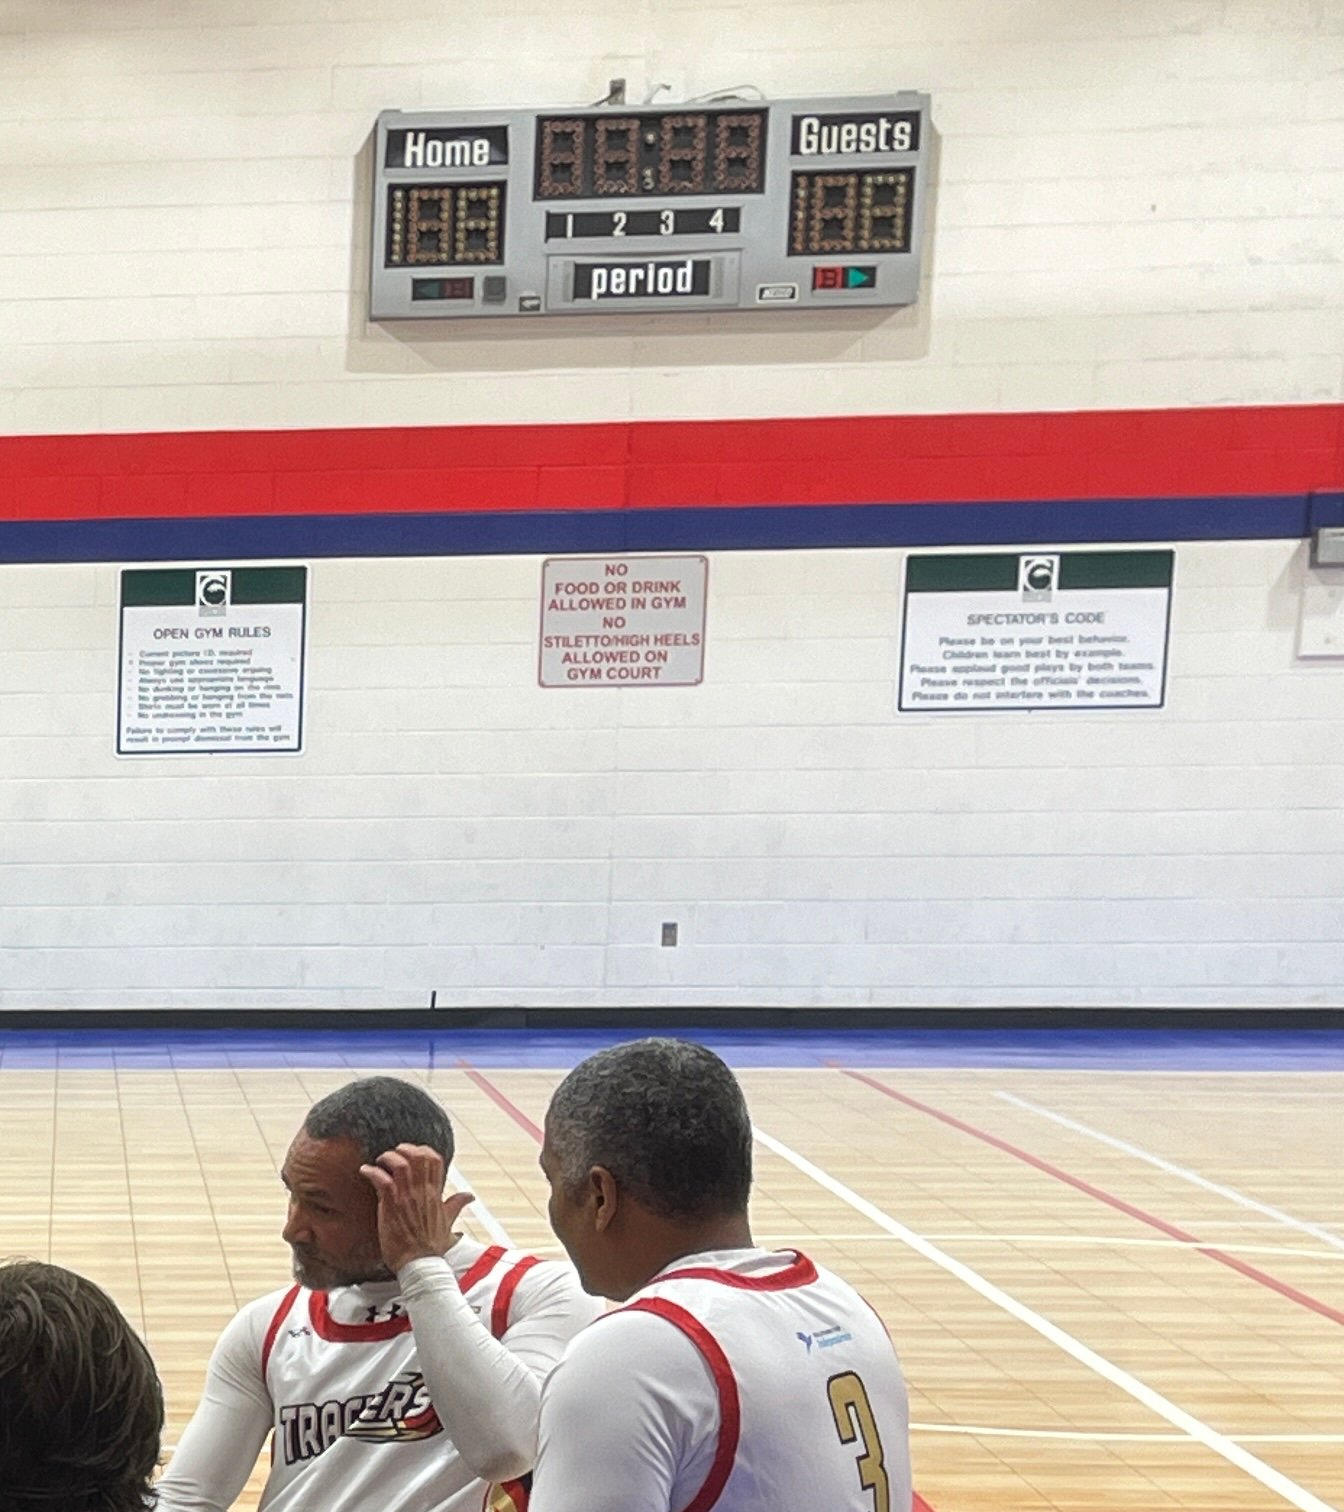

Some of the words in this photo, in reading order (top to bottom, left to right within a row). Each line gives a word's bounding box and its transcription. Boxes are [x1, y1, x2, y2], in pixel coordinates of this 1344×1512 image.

[799, 116, 911, 154] Guests
[404, 132, 489, 168] Home
[565, 214, 573, 238] 1
[612, 213, 627, 236] 2
[659, 211, 675, 235] 3
[709, 209, 724, 233] 4
[591, 261, 692, 300] period
[605, 564, 628, 576] NO
[555, 583, 599, 595] FOOD
[604, 582, 627, 593] OR
[632, 581, 681, 593] DRINK
[548, 598, 626, 611] ALLOWED
[631, 598, 646, 609] IN
[651, 597, 686, 609] GYM
[602, 616, 626, 628] NO
[1065, 612, 1104, 624] CODE
[153, 628, 189, 639] OPEN
[195, 628, 223, 639] GYM
[229, 626, 271, 638] RULES
[654, 633, 700, 646] HEELS
[562, 651, 641, 664] ALLOWED
[645, 650, 668, 662] ON
[567, 668, 602, 679] GYM
[606, 666, 661, 679] COURT
